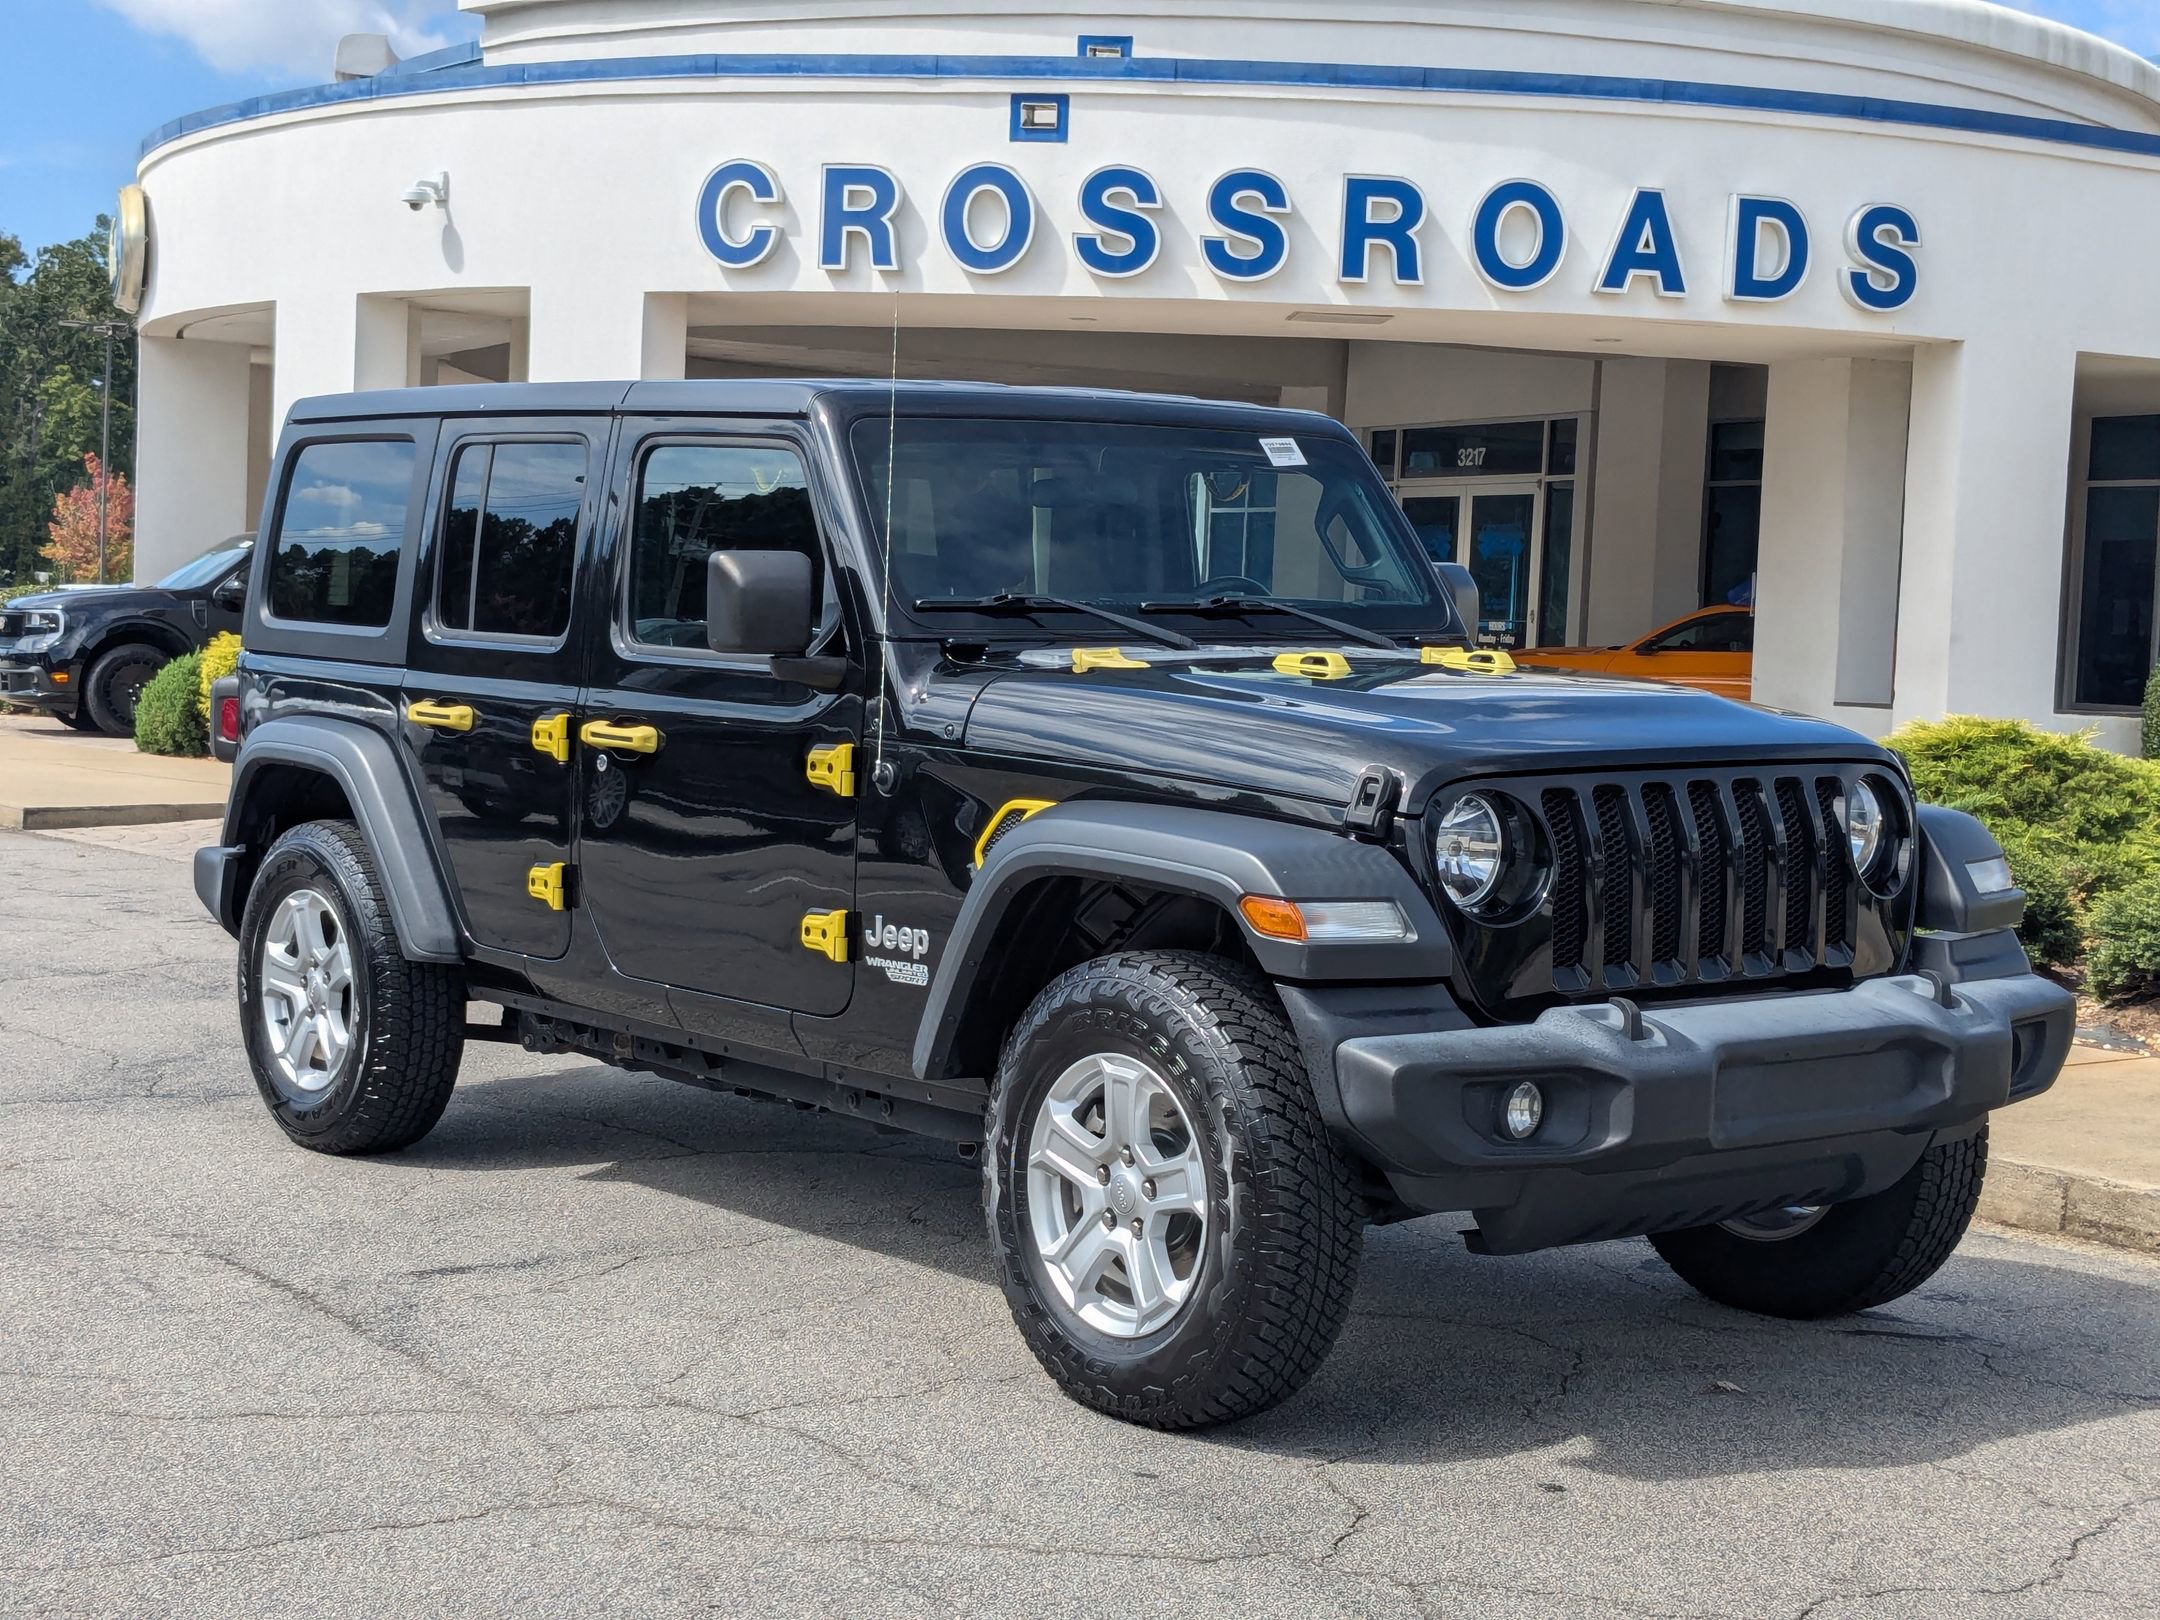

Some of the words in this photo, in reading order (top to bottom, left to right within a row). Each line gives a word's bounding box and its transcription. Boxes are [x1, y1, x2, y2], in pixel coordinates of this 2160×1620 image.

[694, 158, 1922, 313] CROSSROADS
[1457, 447, 1487, 467] 3217
[865, 914, 929, 960] Jeep
[865, 955, 928, 973] WRANGLER
